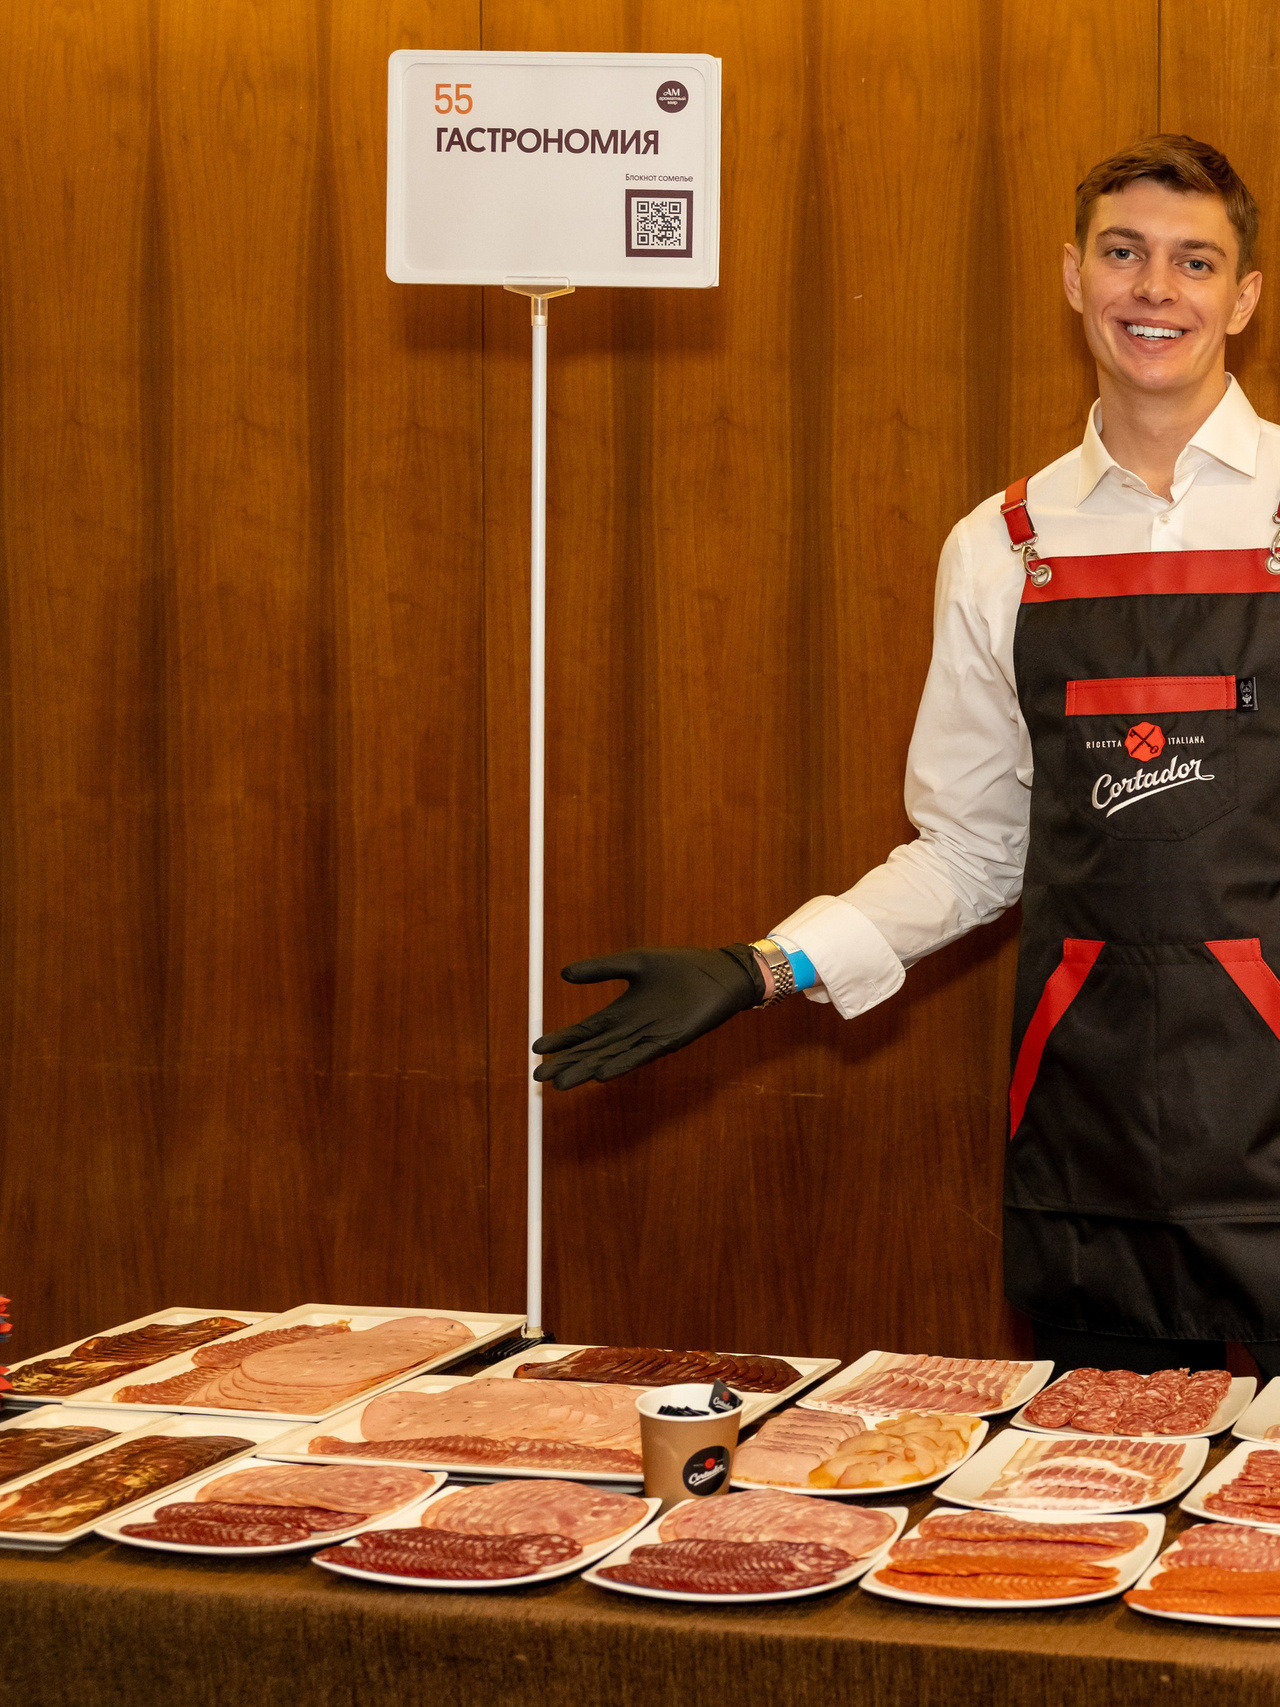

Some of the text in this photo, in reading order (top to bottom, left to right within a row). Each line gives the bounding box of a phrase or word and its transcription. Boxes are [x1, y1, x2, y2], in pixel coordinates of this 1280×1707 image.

[434, 83, 473, 115] 55
[436, 127, 659, 155] ГАСТРОНОМИЯ
[625, 173, 657, 182] Блокнот
[1085, 735, 1206, 749] RICETTA ITALIANA
[1091, 755, 1215, 816] Cortador
